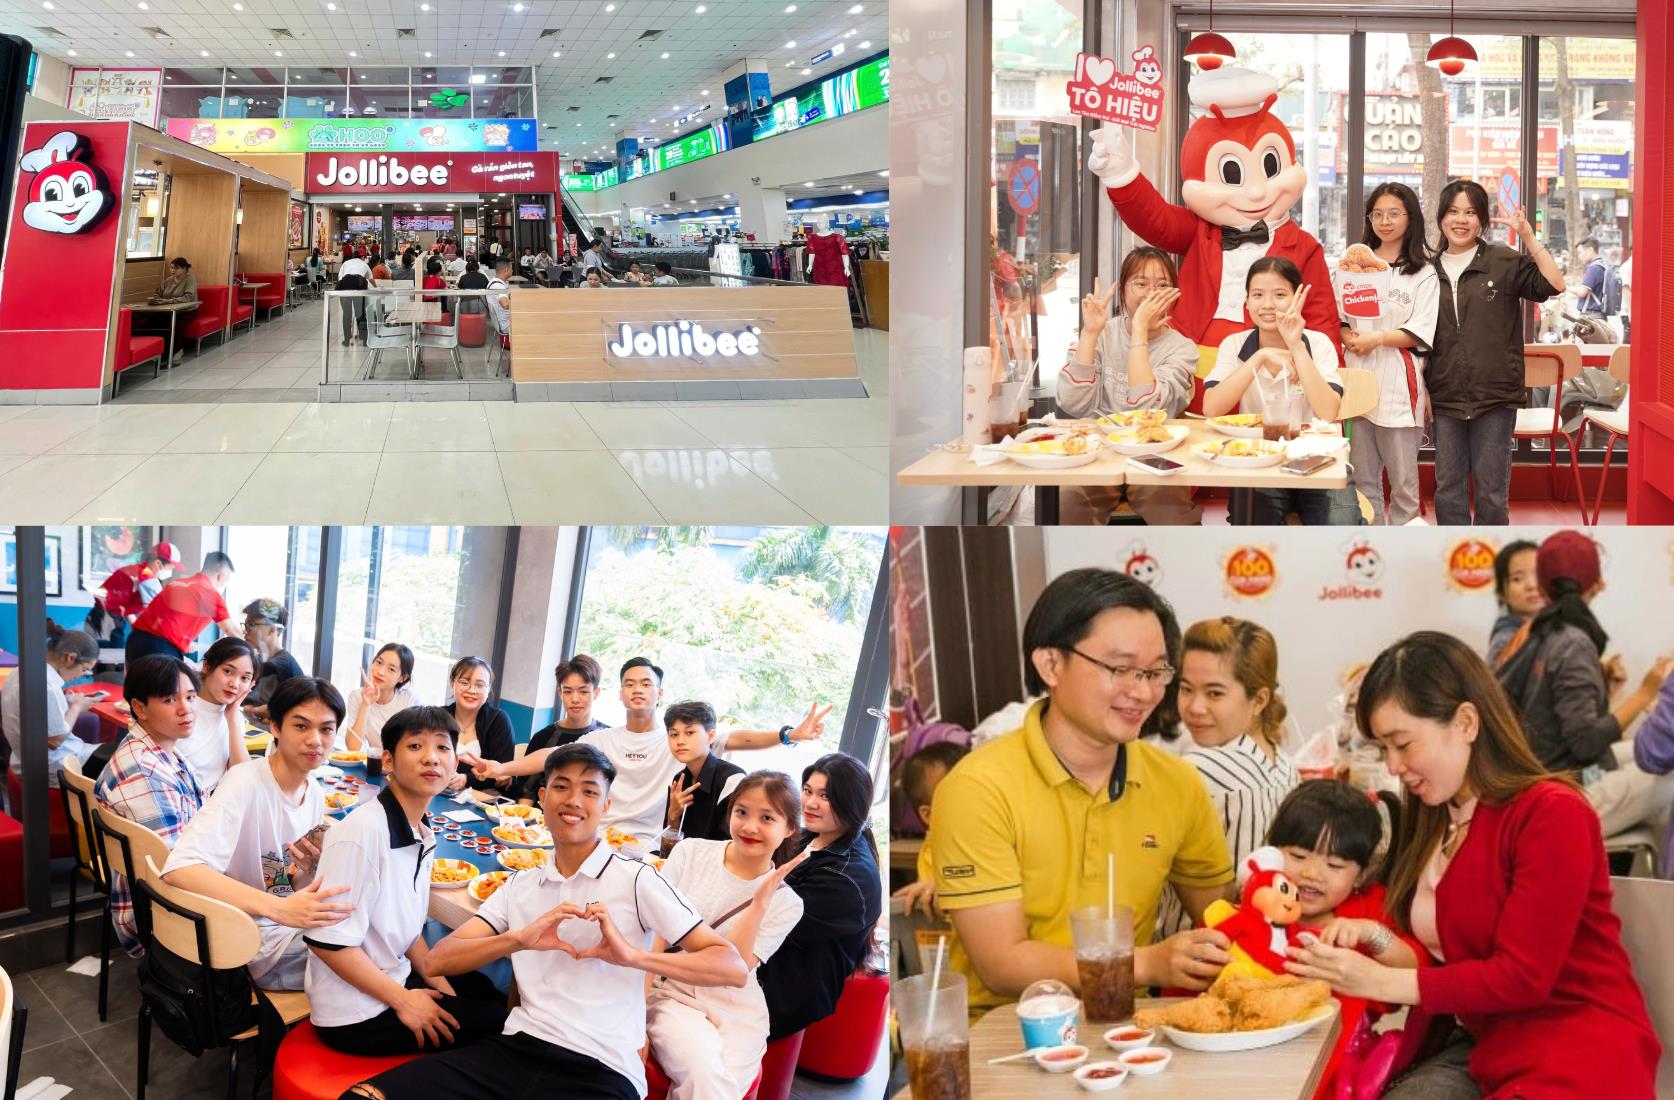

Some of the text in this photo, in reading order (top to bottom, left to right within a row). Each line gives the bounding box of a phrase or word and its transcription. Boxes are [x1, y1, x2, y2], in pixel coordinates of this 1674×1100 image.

[1076, 53, 1085, 82] I
[1109, 77, 1160, 99] Jollibee
[1071, 86, 1158, 122] TÔ HIỆU
[1364, 124, 1422, 151] CÁO
[317, 155, 448, 186] Jollibee
[471, 160, 534, 174] Gà rán giòn tan,
[493, 170, 535, 182] ngon tuyệt
[611, 320, 760, 357] Jollibee
[1233, 559, 1269, 577] 100
[1456, 552, 1493, 569] 100
[1318, 586, 1383, 600] Jollibee
